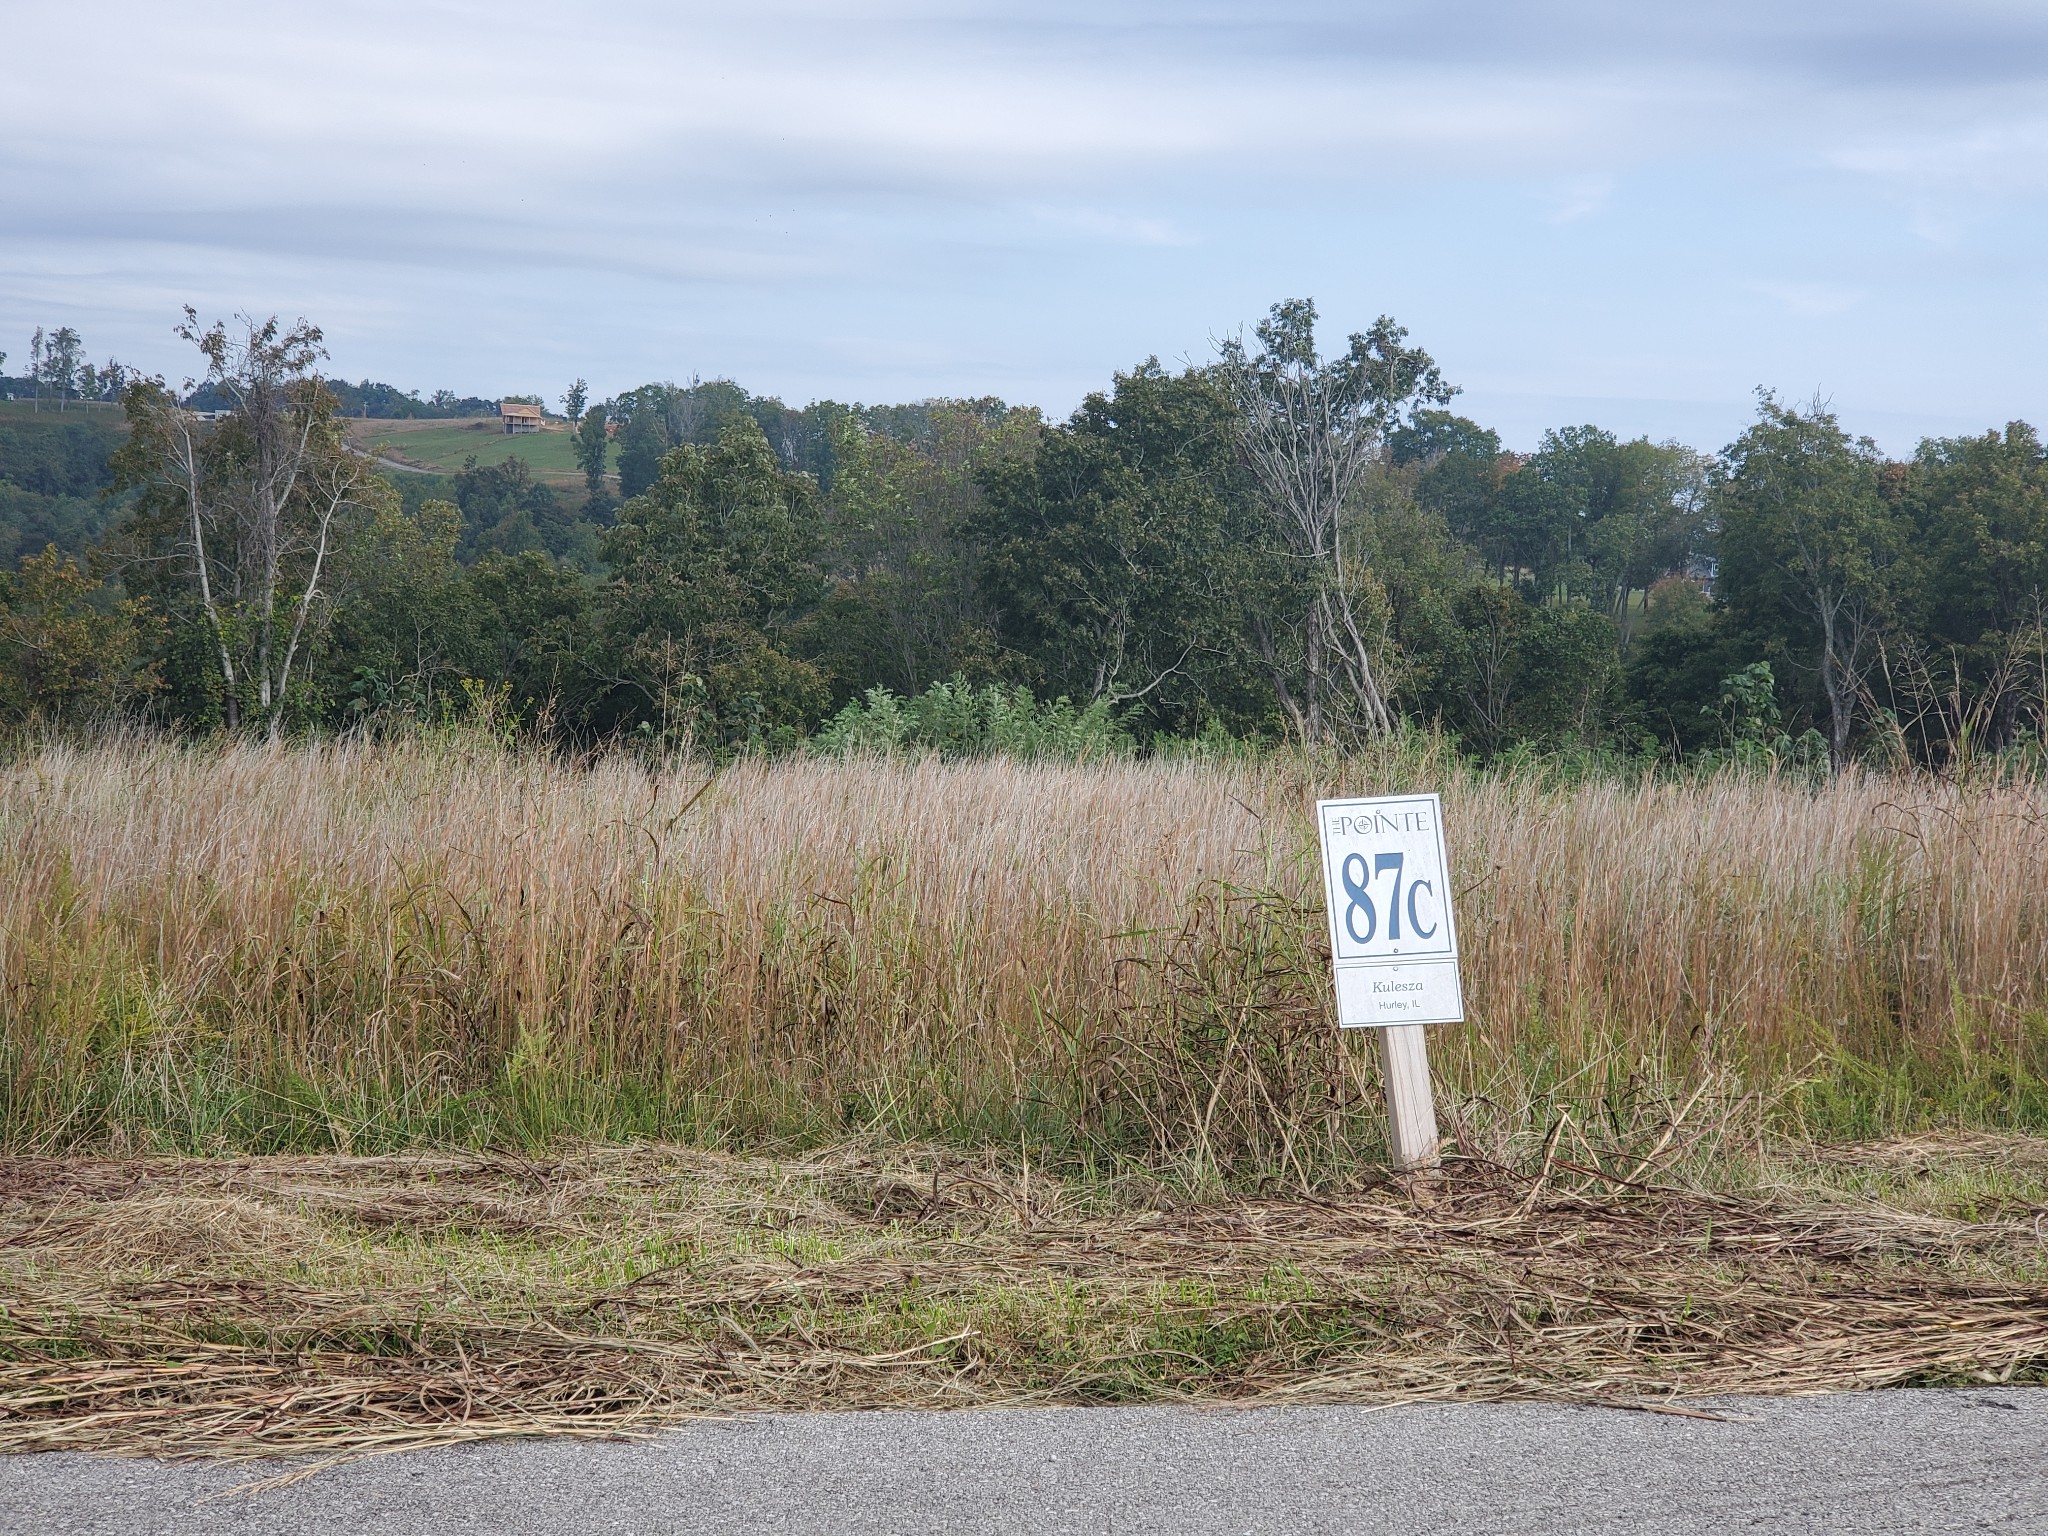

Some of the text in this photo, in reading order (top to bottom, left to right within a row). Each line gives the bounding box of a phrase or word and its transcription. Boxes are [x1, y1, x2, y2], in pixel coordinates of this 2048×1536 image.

[1331, 810, 1430, 836] THE POINTE
[1372, 980, 1424, 993] Kulesza
[1378, 999, 1421, 1010] Hurley, IL
